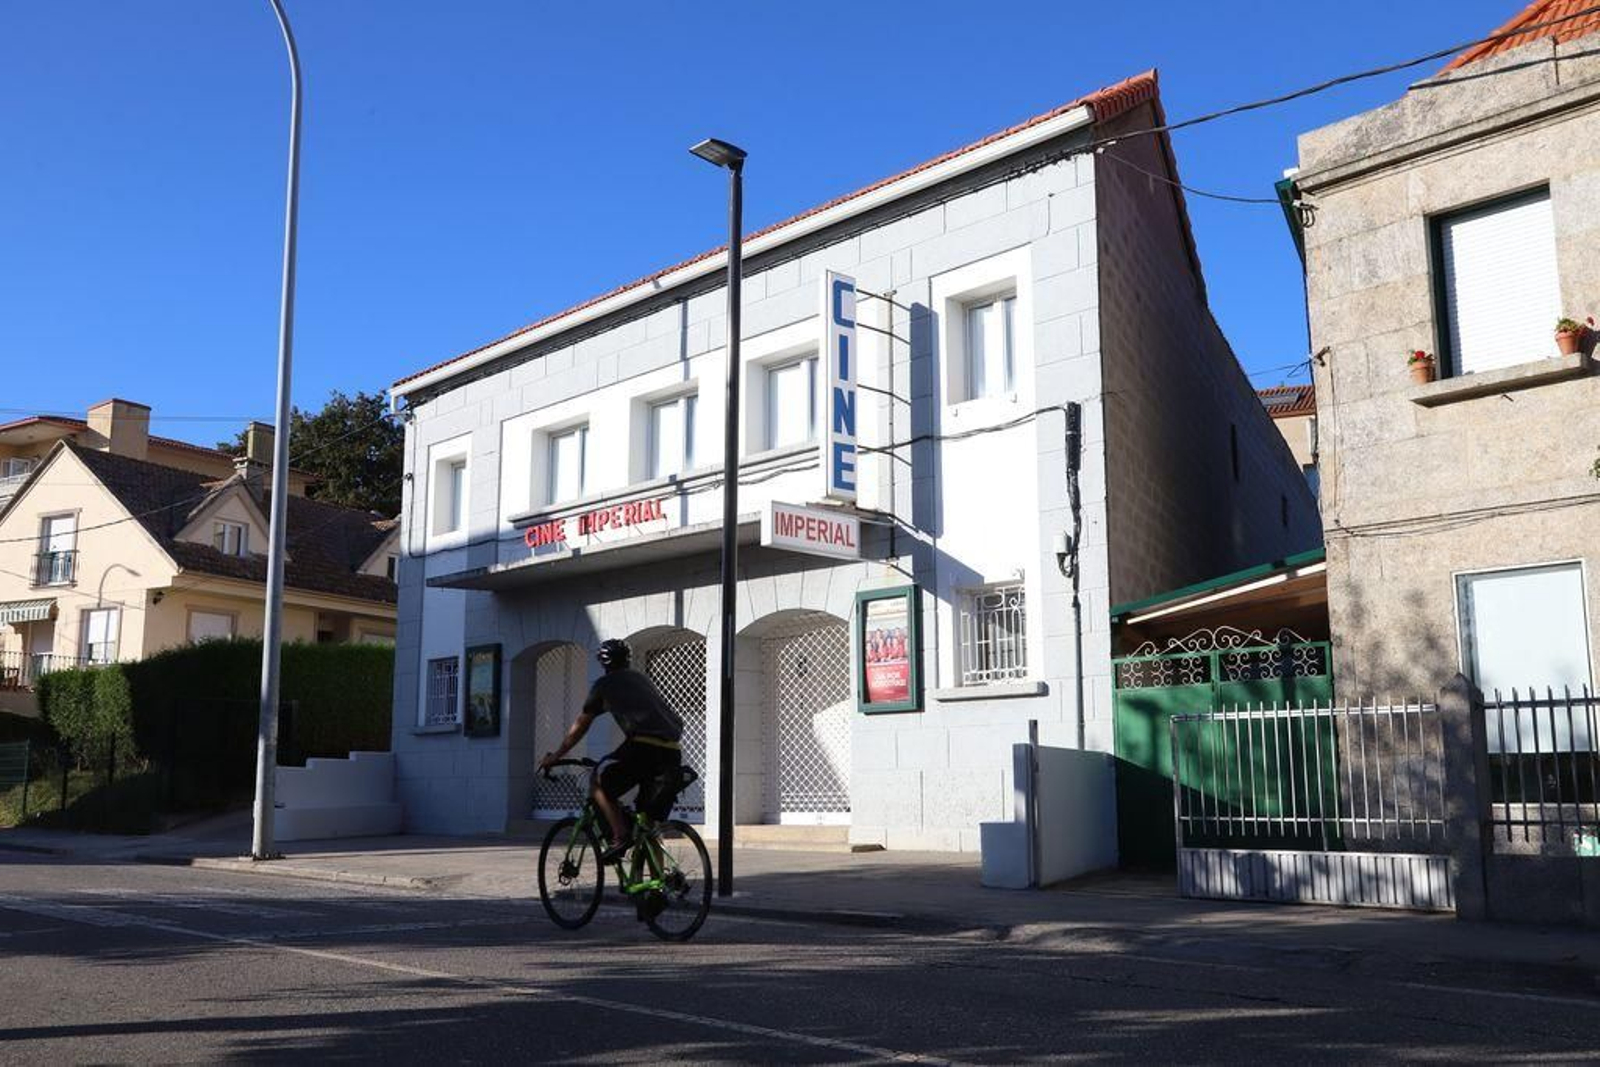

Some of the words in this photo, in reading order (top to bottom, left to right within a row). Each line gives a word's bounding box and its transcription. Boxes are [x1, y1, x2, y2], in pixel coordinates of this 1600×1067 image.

[833, 279, 856, 492] CINE
[524, 518, 567, 549] CINE
[577, 499, 667, 536] IMPERIAL
[774, 511, 856, 548] IMPERIAL
